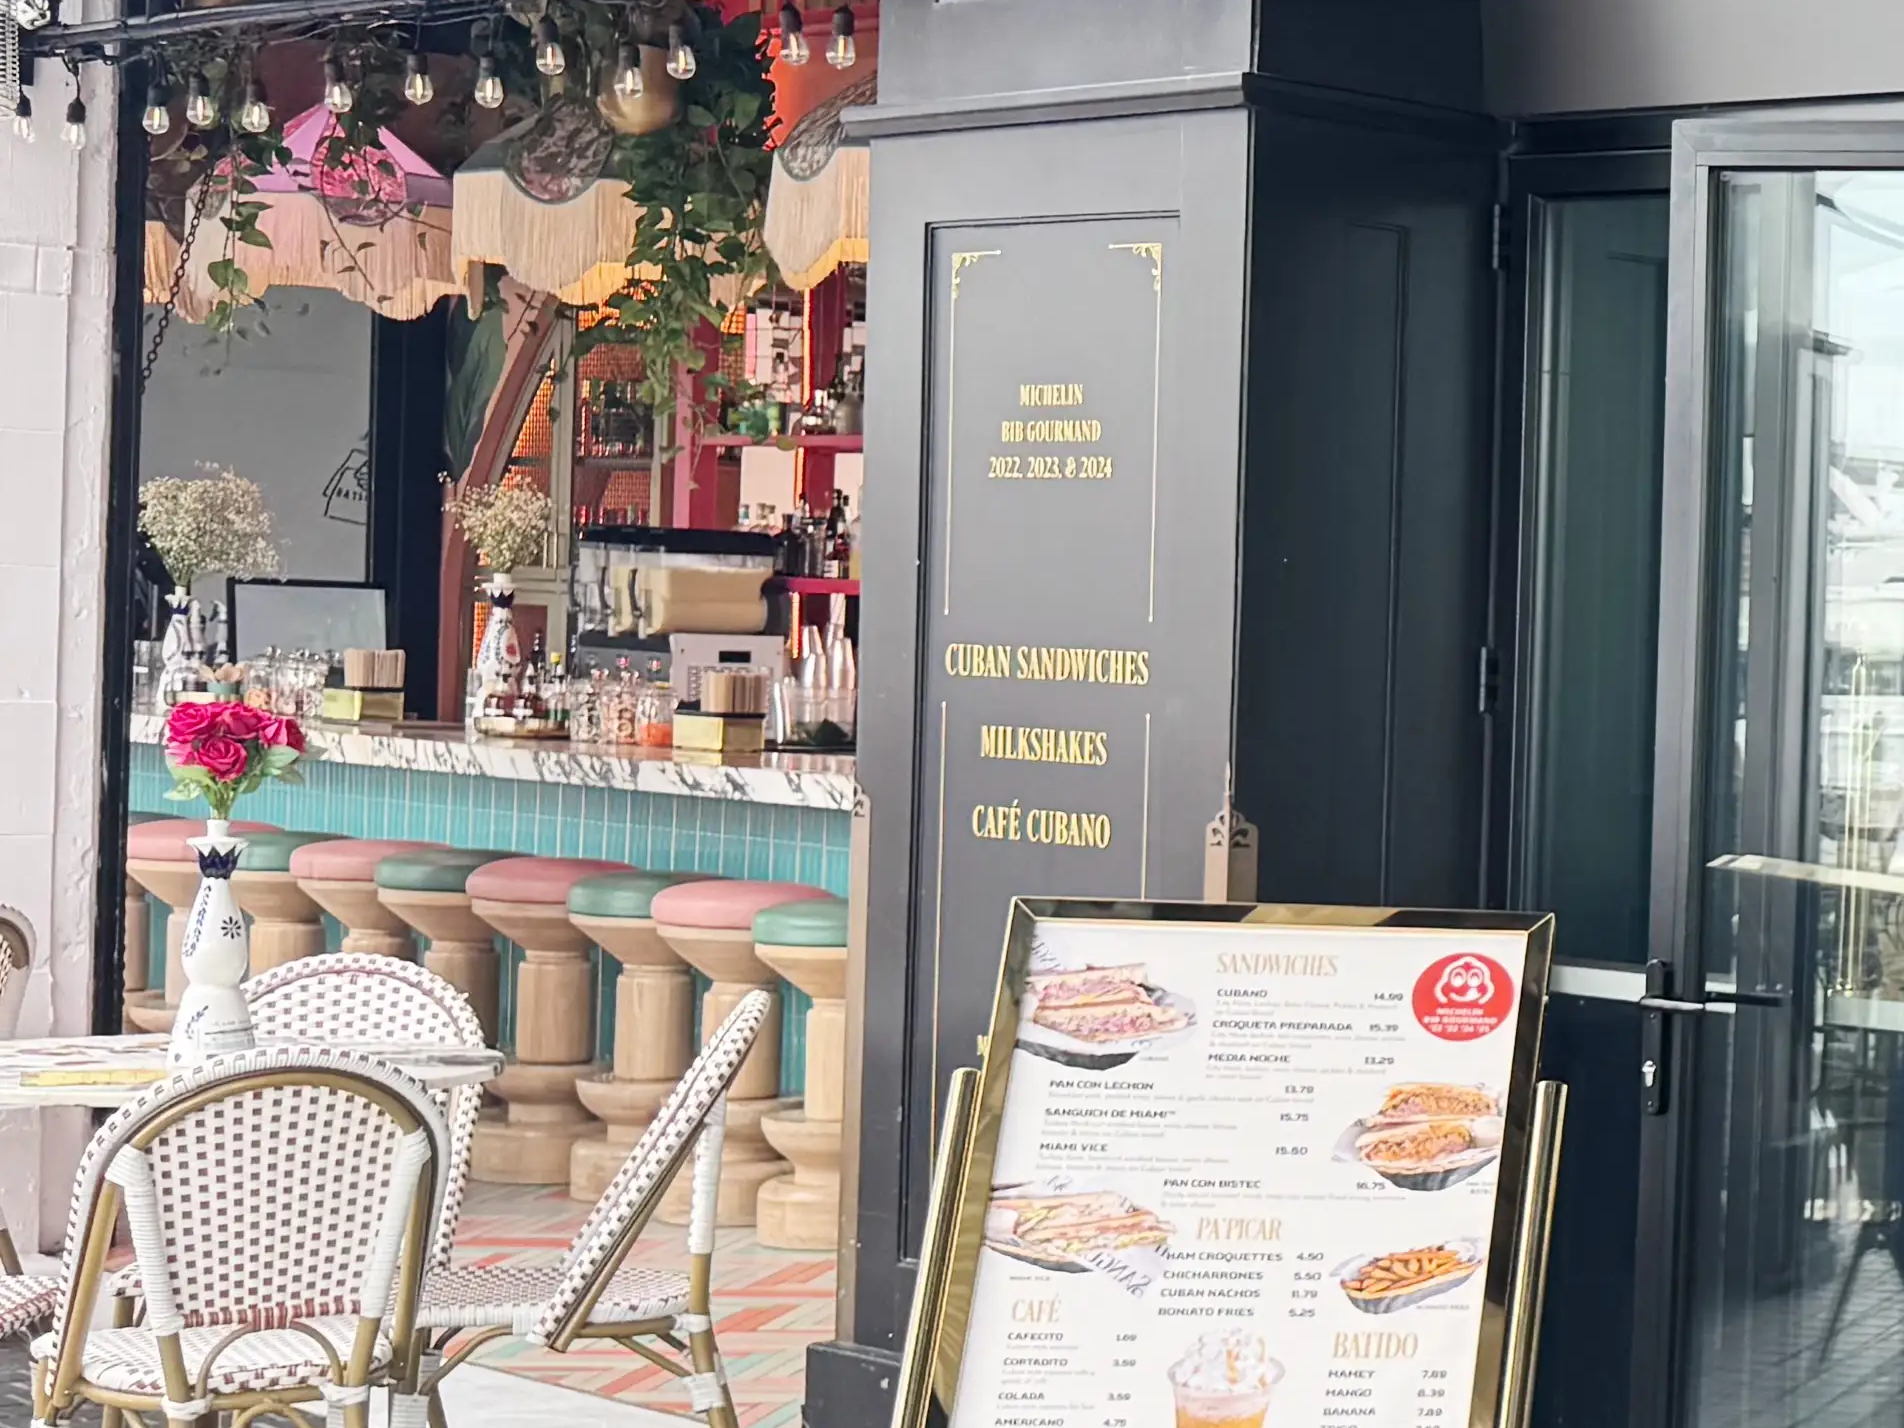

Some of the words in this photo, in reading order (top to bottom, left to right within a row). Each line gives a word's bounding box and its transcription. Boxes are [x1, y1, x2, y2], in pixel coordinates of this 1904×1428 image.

[1018, 382, 1084, 407] MICHELIN
[1000, 419, 1024, 443] BIB
[1025, 418, 1102, 443] GOURMAND
[1063, 455, 1077, 479] &
[1077, 455, 1113, 479] 2024
[944, 642, 1012, 678] CUBAN
[1015, 644, 1149, 686] SANDWICHES
[979, 723, 1108, 766] MILKSHAKES
[971, 799, 1022, 841] CAFÉ
[1025, 807, 1111, 849] CUBANO
[1216, 952, 1339, 977] SANDWICHES
[1216, 988, 1268, 999] CUBANO
[1212, 1020, 1277, 1032] CROQUETA
[1279, 1021, 1353, 1032] PREPARADA
[1207, 1053, 1247, 1063] MEDIA
[1248, 1053, 1291, 1064] NOCHE
[1049, 1079, 1074, 1090] PAN
[1076, 1080, 1102, 1090] CON
[1039, 1142, 1077, 1153] MIAMI
[1079, 1143, 1108, 1153] VICE
[1163, 1178, 1188, 1189] PAN
[1190, 1178, 1216, 1189] CON
[1218, 1179, 1262, 1189] BISTEC
[1166, 1251, 1197, 1263] HAM
[1198, 1251, 1284, 1263] CROQUETTES
[1162, 1270, 1264, 1282] CHICHARRONES
[1160, 1288, 1206, 1299] CUBAN
[1207, 1288, 1261, 1299] NACHOS
[1011, 1291, 1062, 1324] CAFÉ
[1157, 1306, 1215, 1318] BONIATO
[1217, 1306, 1255, 1318] FRIES
[1332, 1331, 1420, 1360] BATIDO
